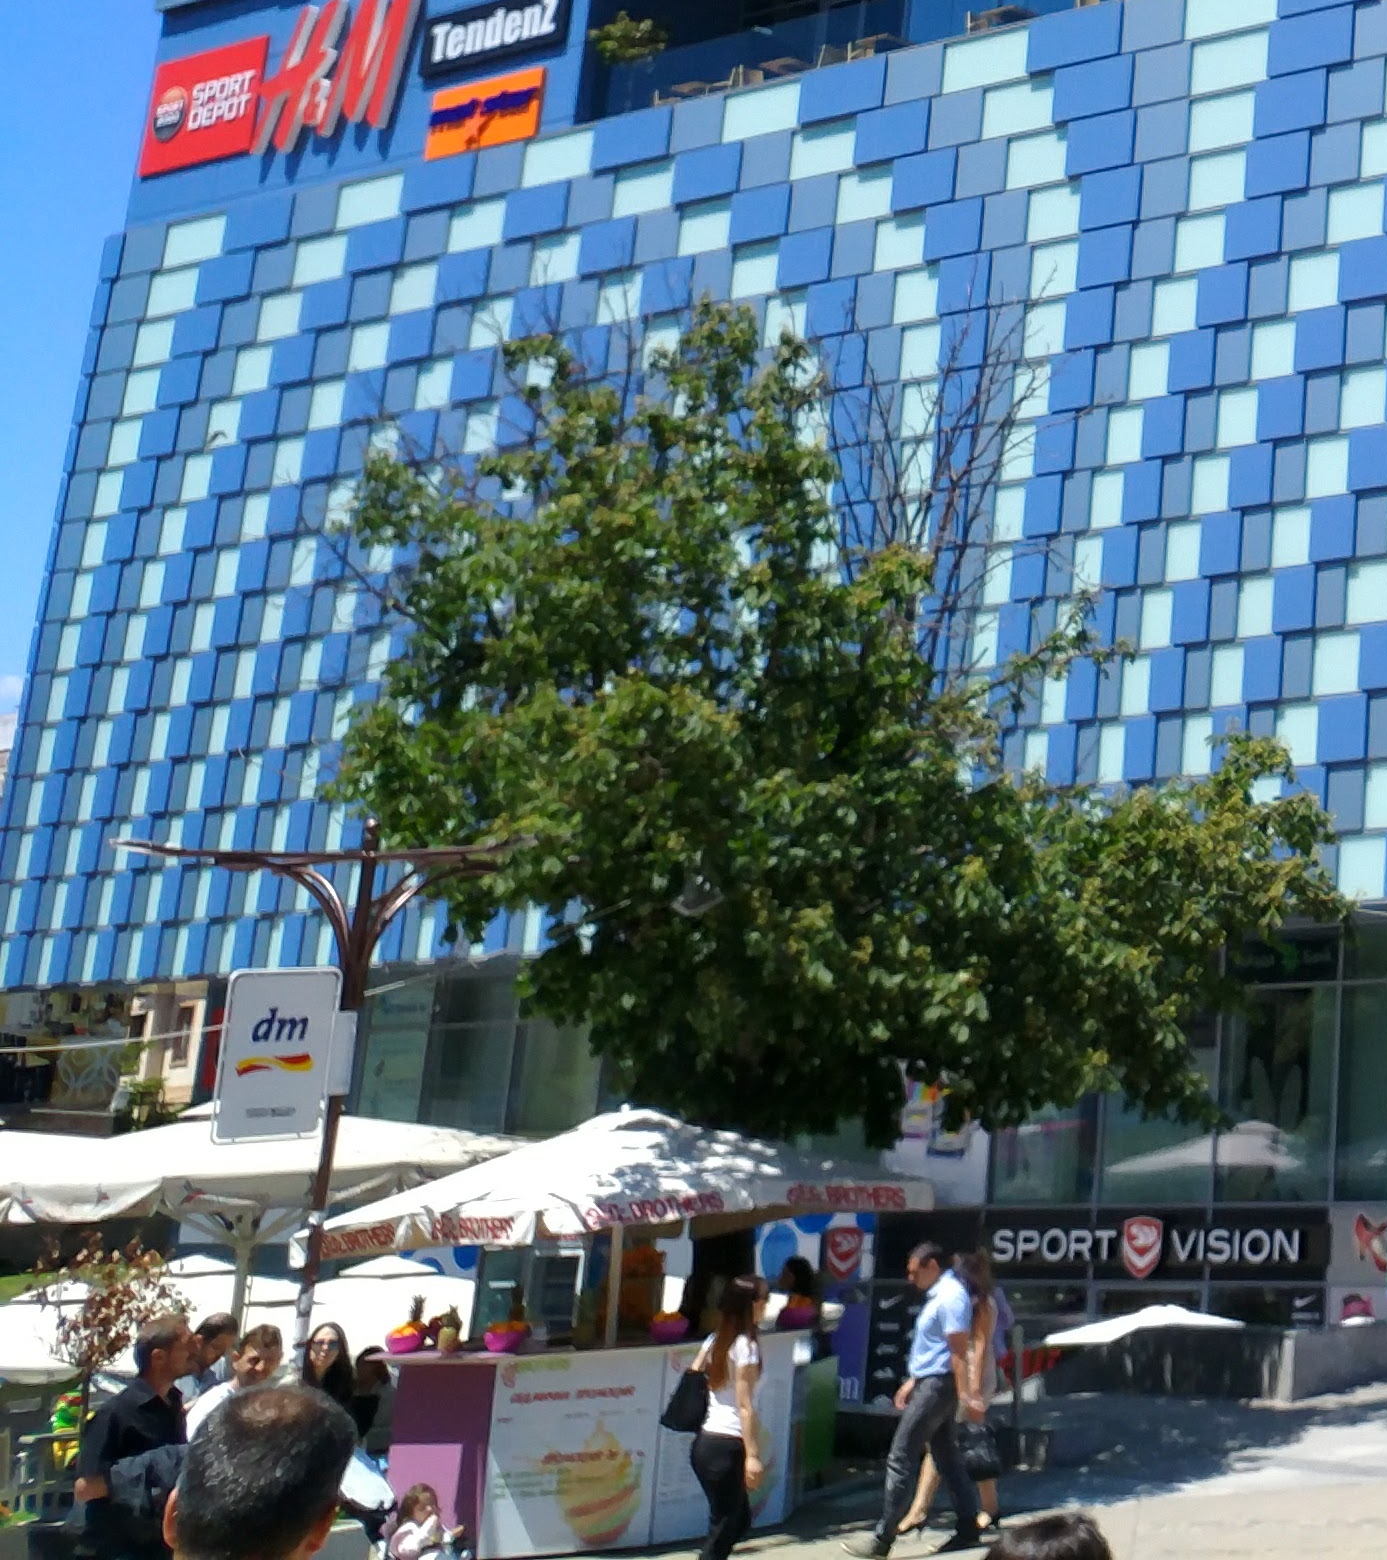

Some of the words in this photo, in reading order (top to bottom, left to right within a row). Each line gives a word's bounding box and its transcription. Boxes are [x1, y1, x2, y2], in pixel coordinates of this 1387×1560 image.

[192, 69, 256, 105] SPORT
[187, 92, 252, 131] DEPOT
[252, 1005, 310, 1042] dm
[991, 1227, 1117, 1263] SPORT
[1171, 1227, 1300, 1263] VISION
